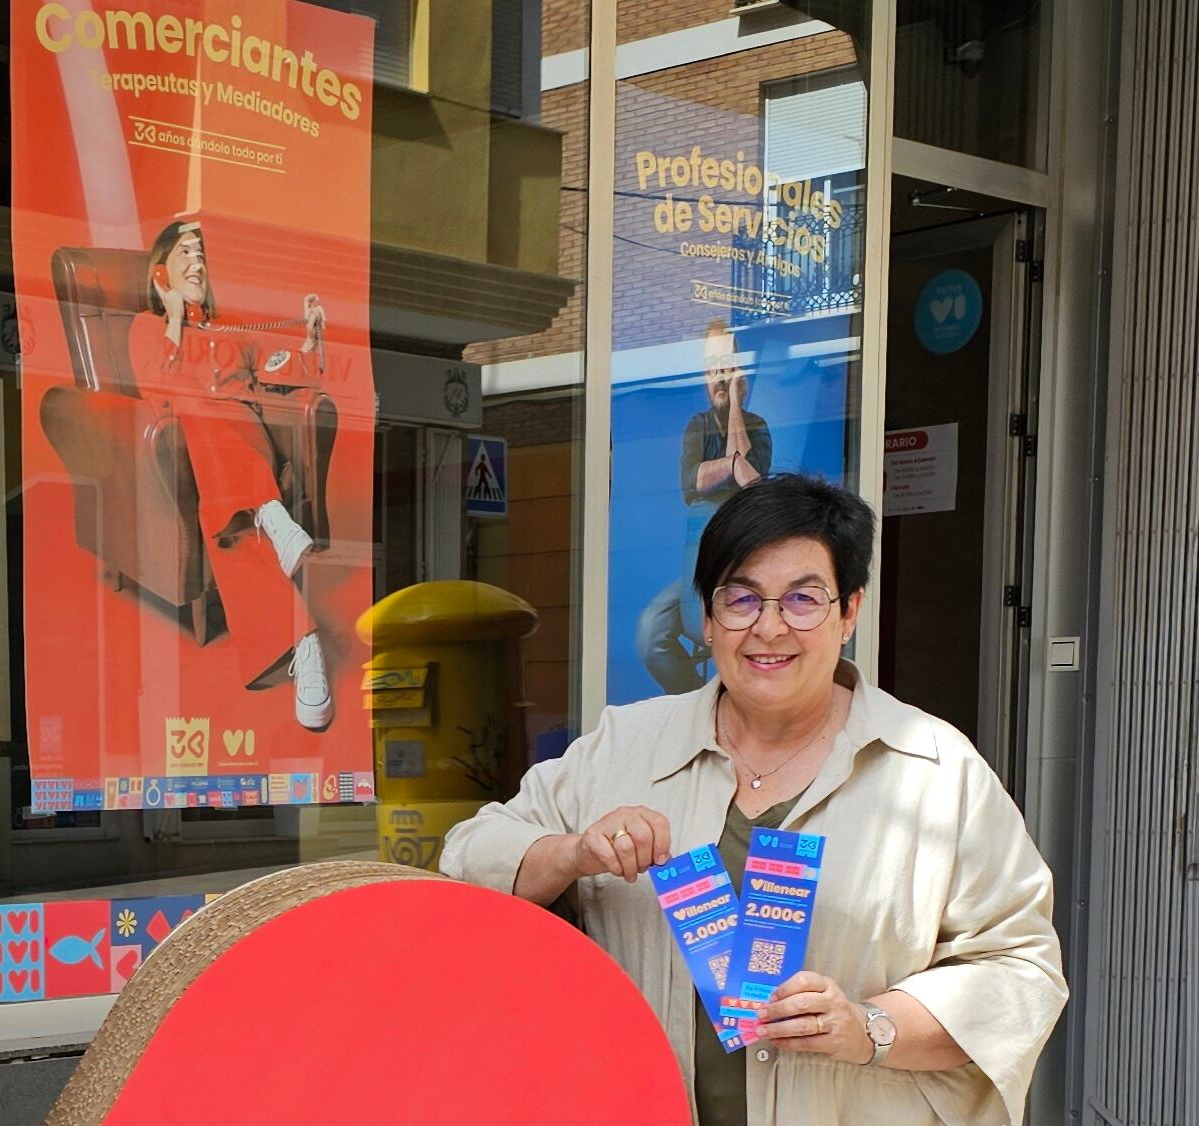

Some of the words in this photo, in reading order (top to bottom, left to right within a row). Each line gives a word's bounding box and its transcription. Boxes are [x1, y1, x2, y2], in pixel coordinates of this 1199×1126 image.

[35, 3, 363, 121] Comerciantes
[201, 81, 214, 105] y
[217, 81, 320, 138] Mediadores
[158, 130, 185, 146] años
[232, 145, 255, 160] todo
[257, 152, 274, 164] por
[654, 192, 693, 234] de
[680, 241, 745, 263] Consejeros
[745, 250, 753, 268] y
[885, 436, 917, 448] RARIO
[750, 878, 811, 898] Villenear
[673, 894, 731, 921] Villenear
[745, 902, 806, 924] 2.000€
[683, 914, 738, 945] 2.000€
